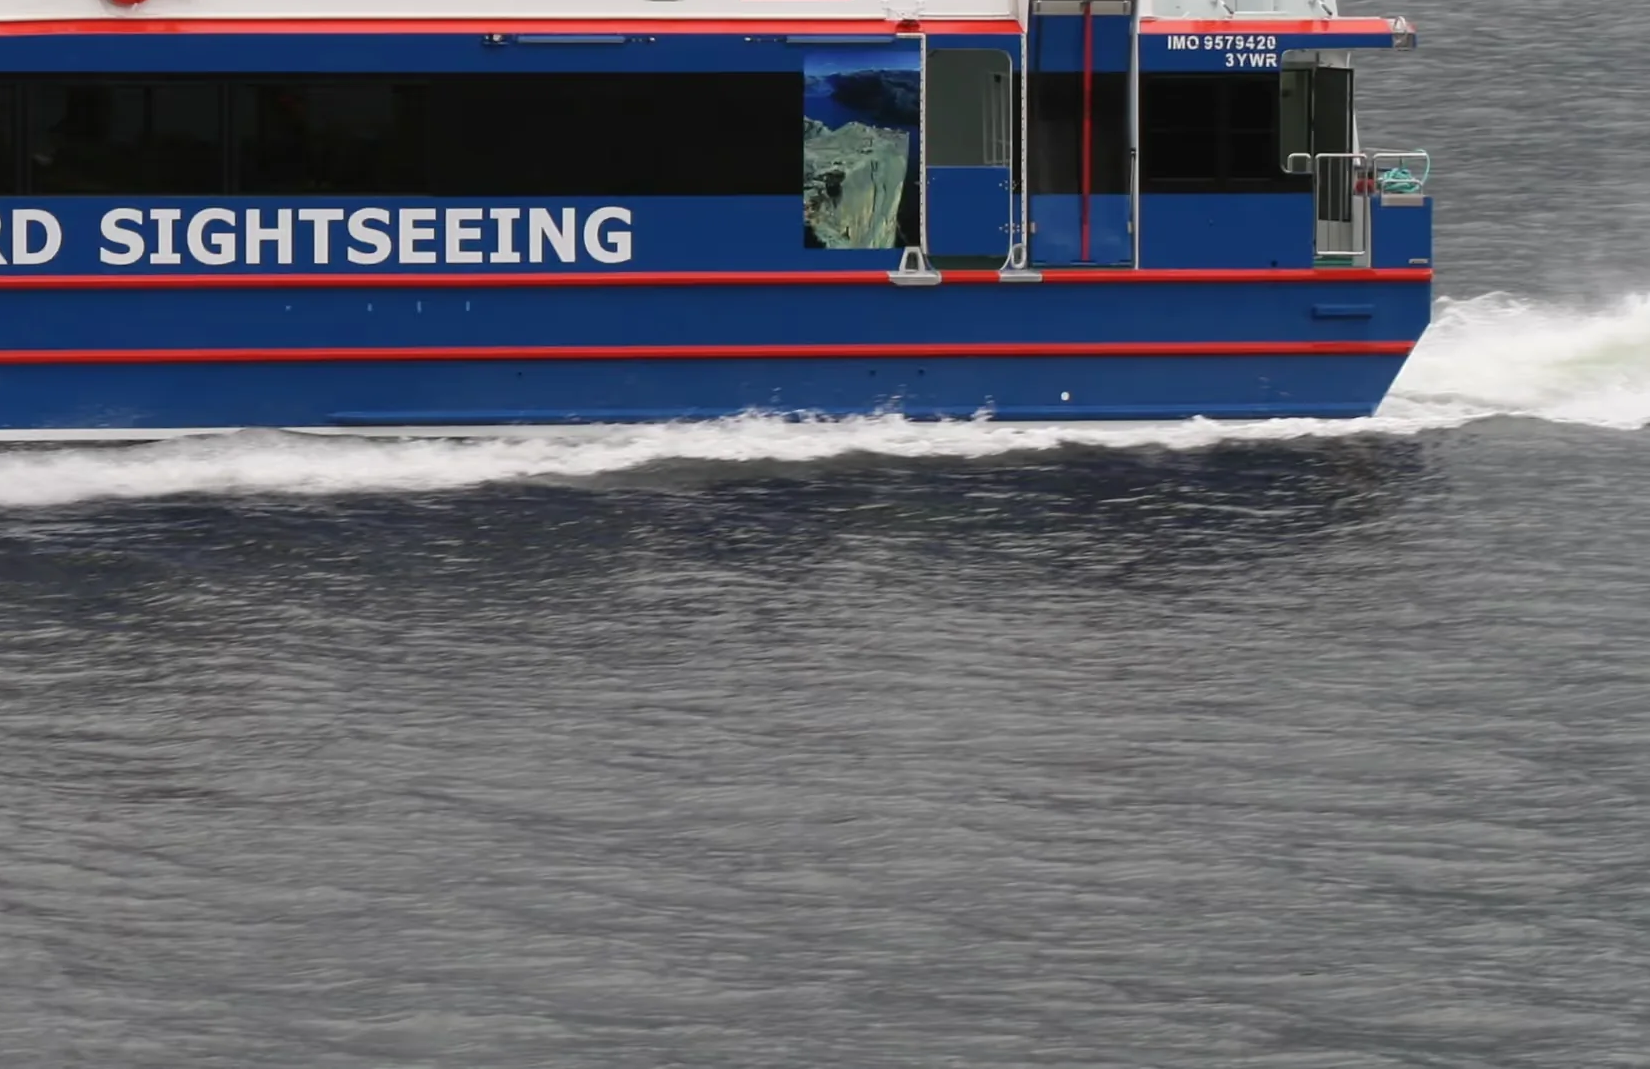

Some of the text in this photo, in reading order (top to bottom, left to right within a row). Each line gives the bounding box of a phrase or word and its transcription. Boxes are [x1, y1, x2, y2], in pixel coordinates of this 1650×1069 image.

[1167, 35, 1276, 50] IMO 9579420
[1225, 52, 1278, 68] 3YWR
[99, 206, 633, 266] SIGHTSEEING
